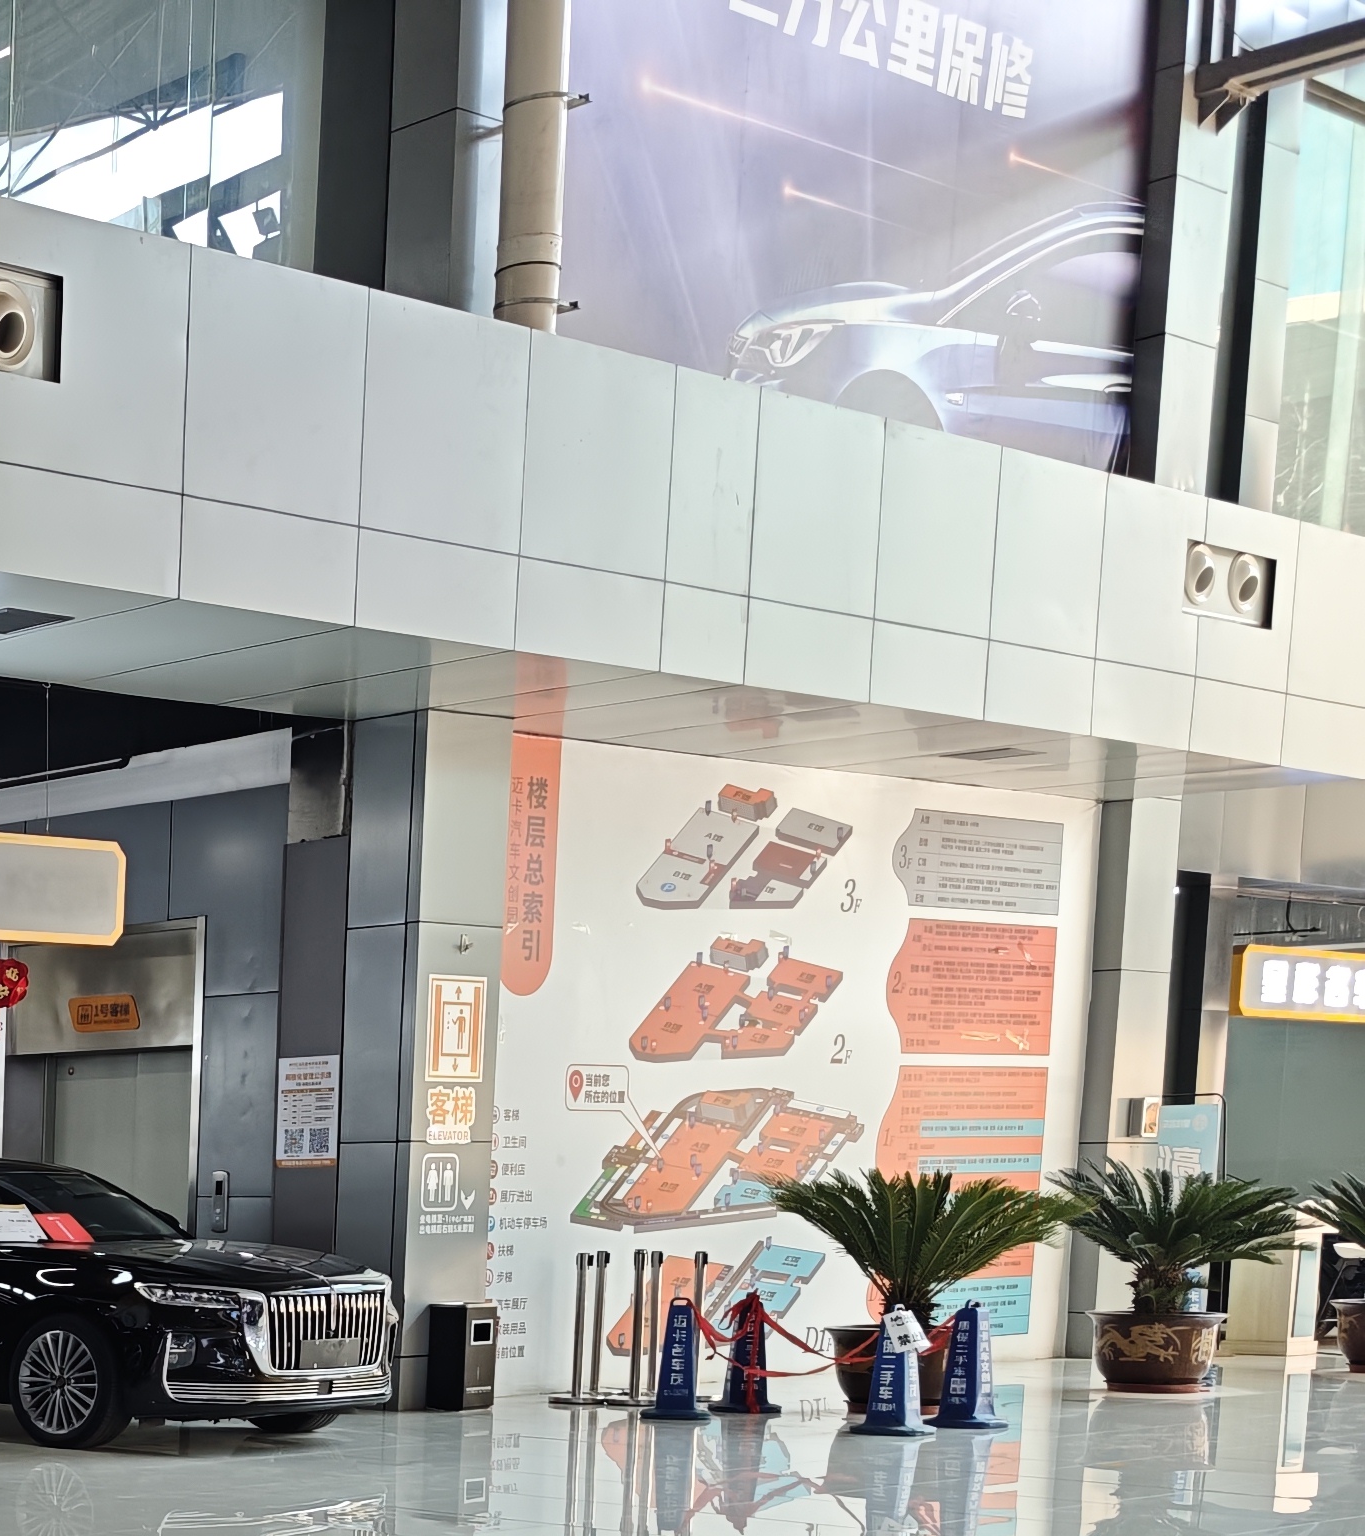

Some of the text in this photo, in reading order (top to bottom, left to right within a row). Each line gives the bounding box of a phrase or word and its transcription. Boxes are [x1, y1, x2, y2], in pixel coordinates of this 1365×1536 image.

[506, 776, 524, 925] 迈卡汽车文创园
[521, 775, 549, 963] 楼层总索引
[840, 878, 862, 914] 3F
[93, 1002, 131, 1018] 1号客梯
[830, 1033, 853, 1065] 2F
[584, 1073, 611, 1088] 当前您
[583, 1090, 626, 1104] 所在的位置
[427, 1088, 475, 1126] 客梯
[503, 1108, 520, 1122] 客梯
[427, 1130, 470, 1141] ELEVATOR
[501, 1135, 528, 1149] 卫生间
[500, 1162, 526, 1177] 便利店
[499, 1189, 533, 1204] 展厅进出
[498, 1216, 548, 1231] 机动车停车场
[496, 1244, 515, 1257] 扶梯
[495, 1271, 513, 1284] 步梯
